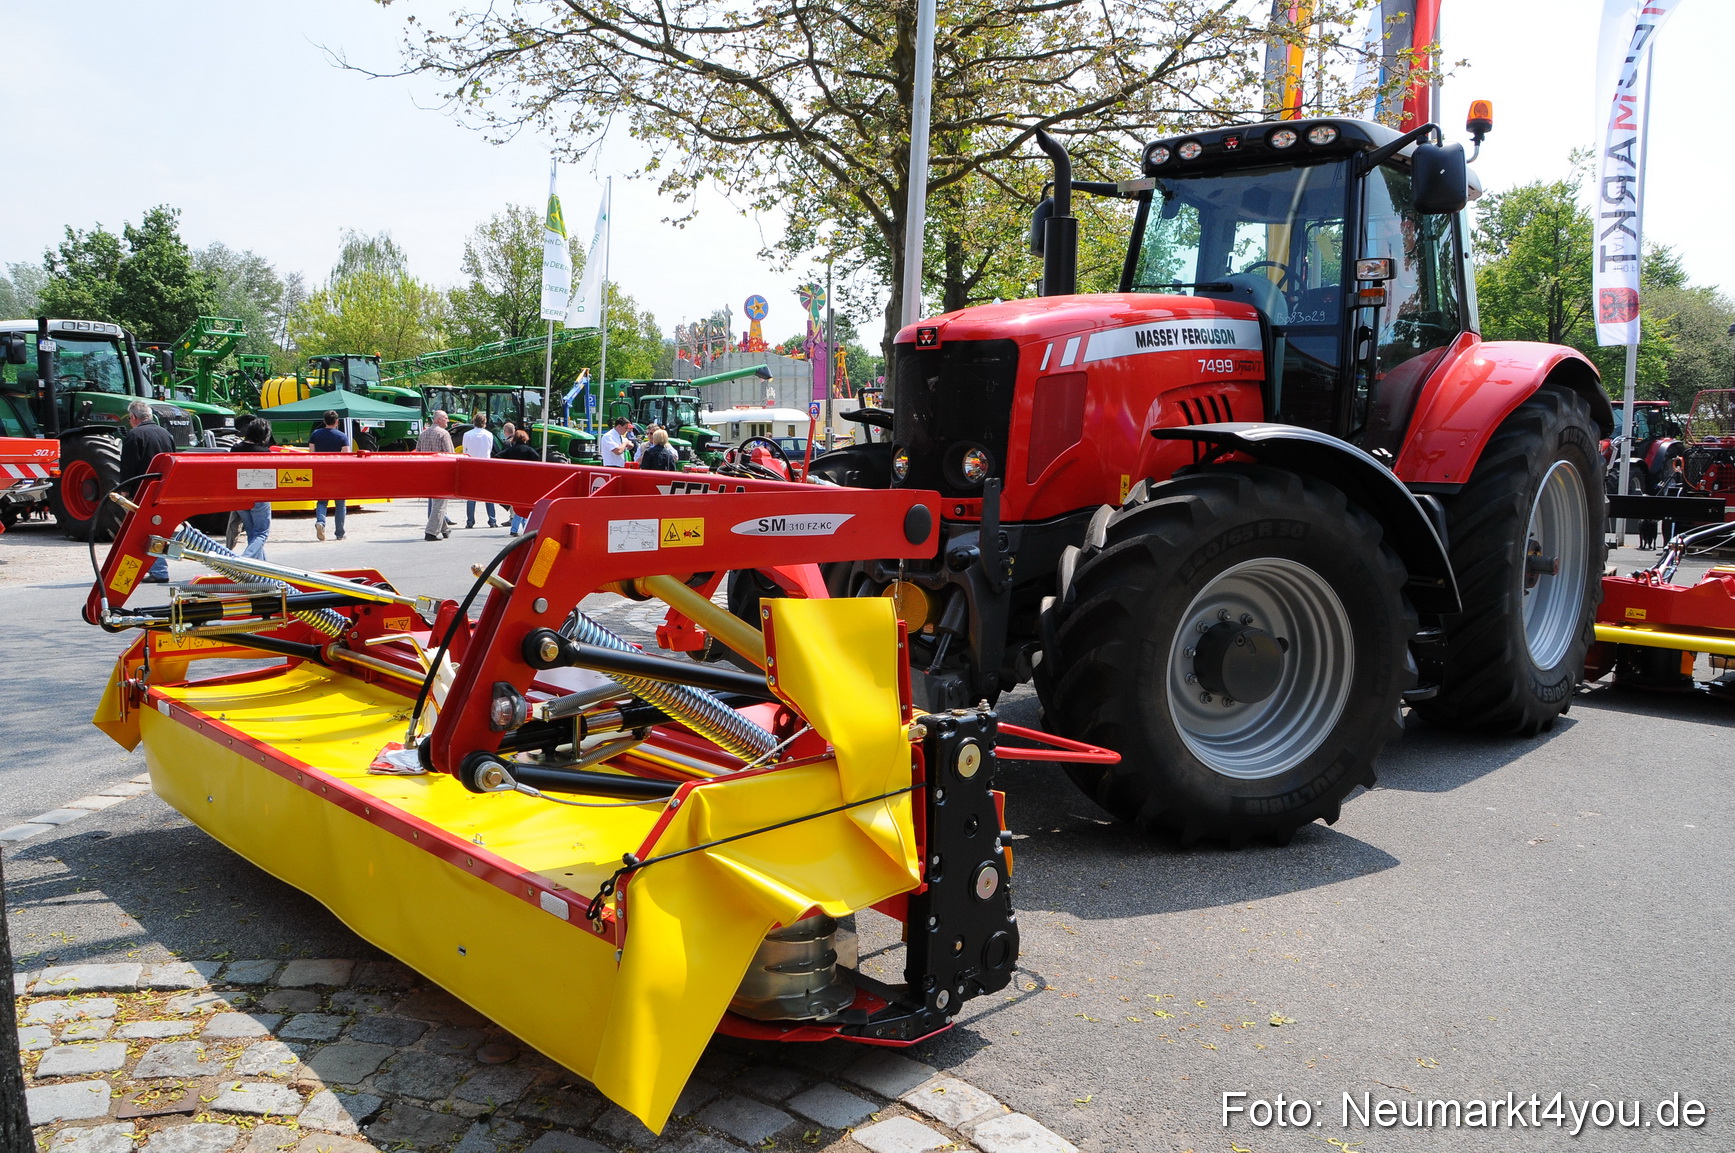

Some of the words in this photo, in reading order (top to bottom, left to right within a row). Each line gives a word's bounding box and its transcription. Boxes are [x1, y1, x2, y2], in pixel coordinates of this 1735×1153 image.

[544, 284, 569, 295] DEERE
[1135, 328, 1179, 349] MASSEY
[1182, 328, 1237, 345] FERGUSON
[1197, 359, 1234, 374] 7499
[33, 449, 56, 457] 30.1
[758, 518, 786, 533] SM
[789, 523, 805, 531] 310
[807, 521, 832, 530] FZ-KC
[1258, 521, 1273, 537] R
[1277, 521, 1305, 538] 30
